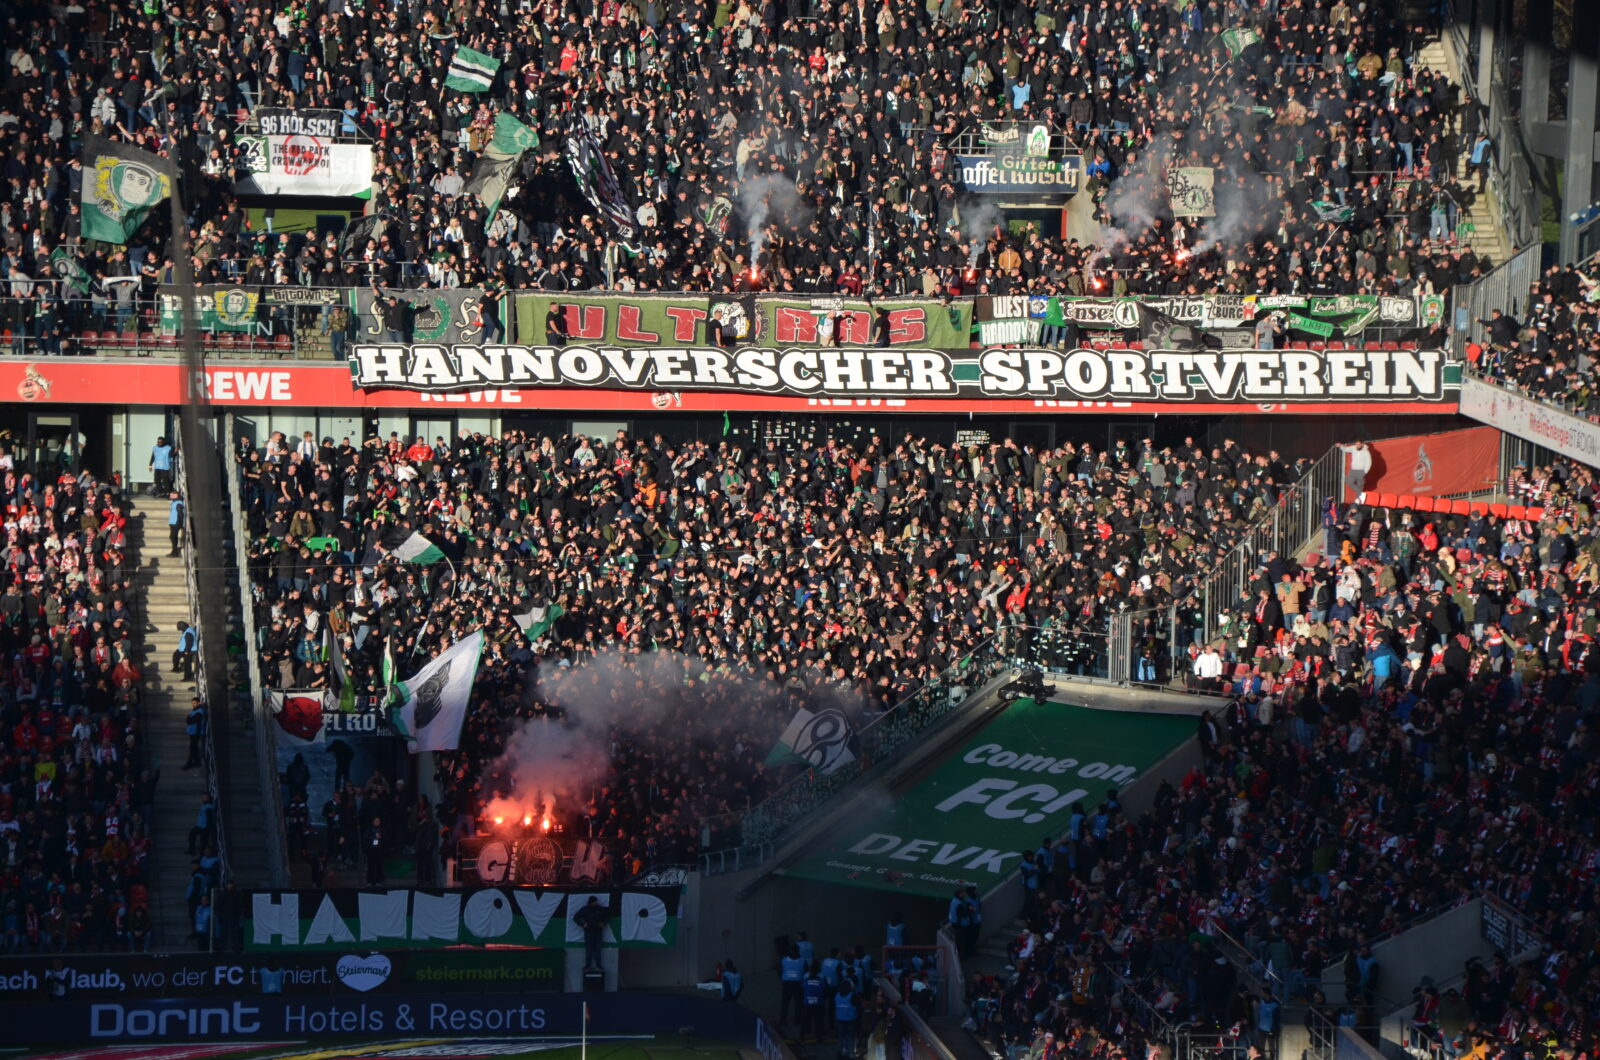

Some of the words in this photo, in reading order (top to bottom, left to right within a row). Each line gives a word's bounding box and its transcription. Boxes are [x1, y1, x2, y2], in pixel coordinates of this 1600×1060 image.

[261, 116, 278, 135] 96
[280, 112, 337, 137] KÖLSCH
[273, 144, 288, 154] THE
[992, 295, 1029, 319] WEST
[1216, 306, 1243, 319] BURG
[356, 347, 950, 391] HANNOVERSCHER
[981, 350, 1440, 394] SPORTVEREIN
[188, 371, 292, 400] REWE
[963, 743, 1079, 774] Come
[934, 778, 1089, 824] FC!
[847, 833, 1023, 874] DEVK
[252, 888, 668, 945] HANNOVER
[132, 972, 171, 988] wo
[173, 966, 208, 986] der
[214, 965, 244, 986] FC
[337, 965, 389, 979] Steiermark
[416, 965, 553, 981] steiermark.com
[90, 1001, 260, 1037] Dorint
[285, 1004, 384, 1033] Hotels
[396, 1004, 415, 1032] &
[430, 1002, 546, 1031] Resorts
